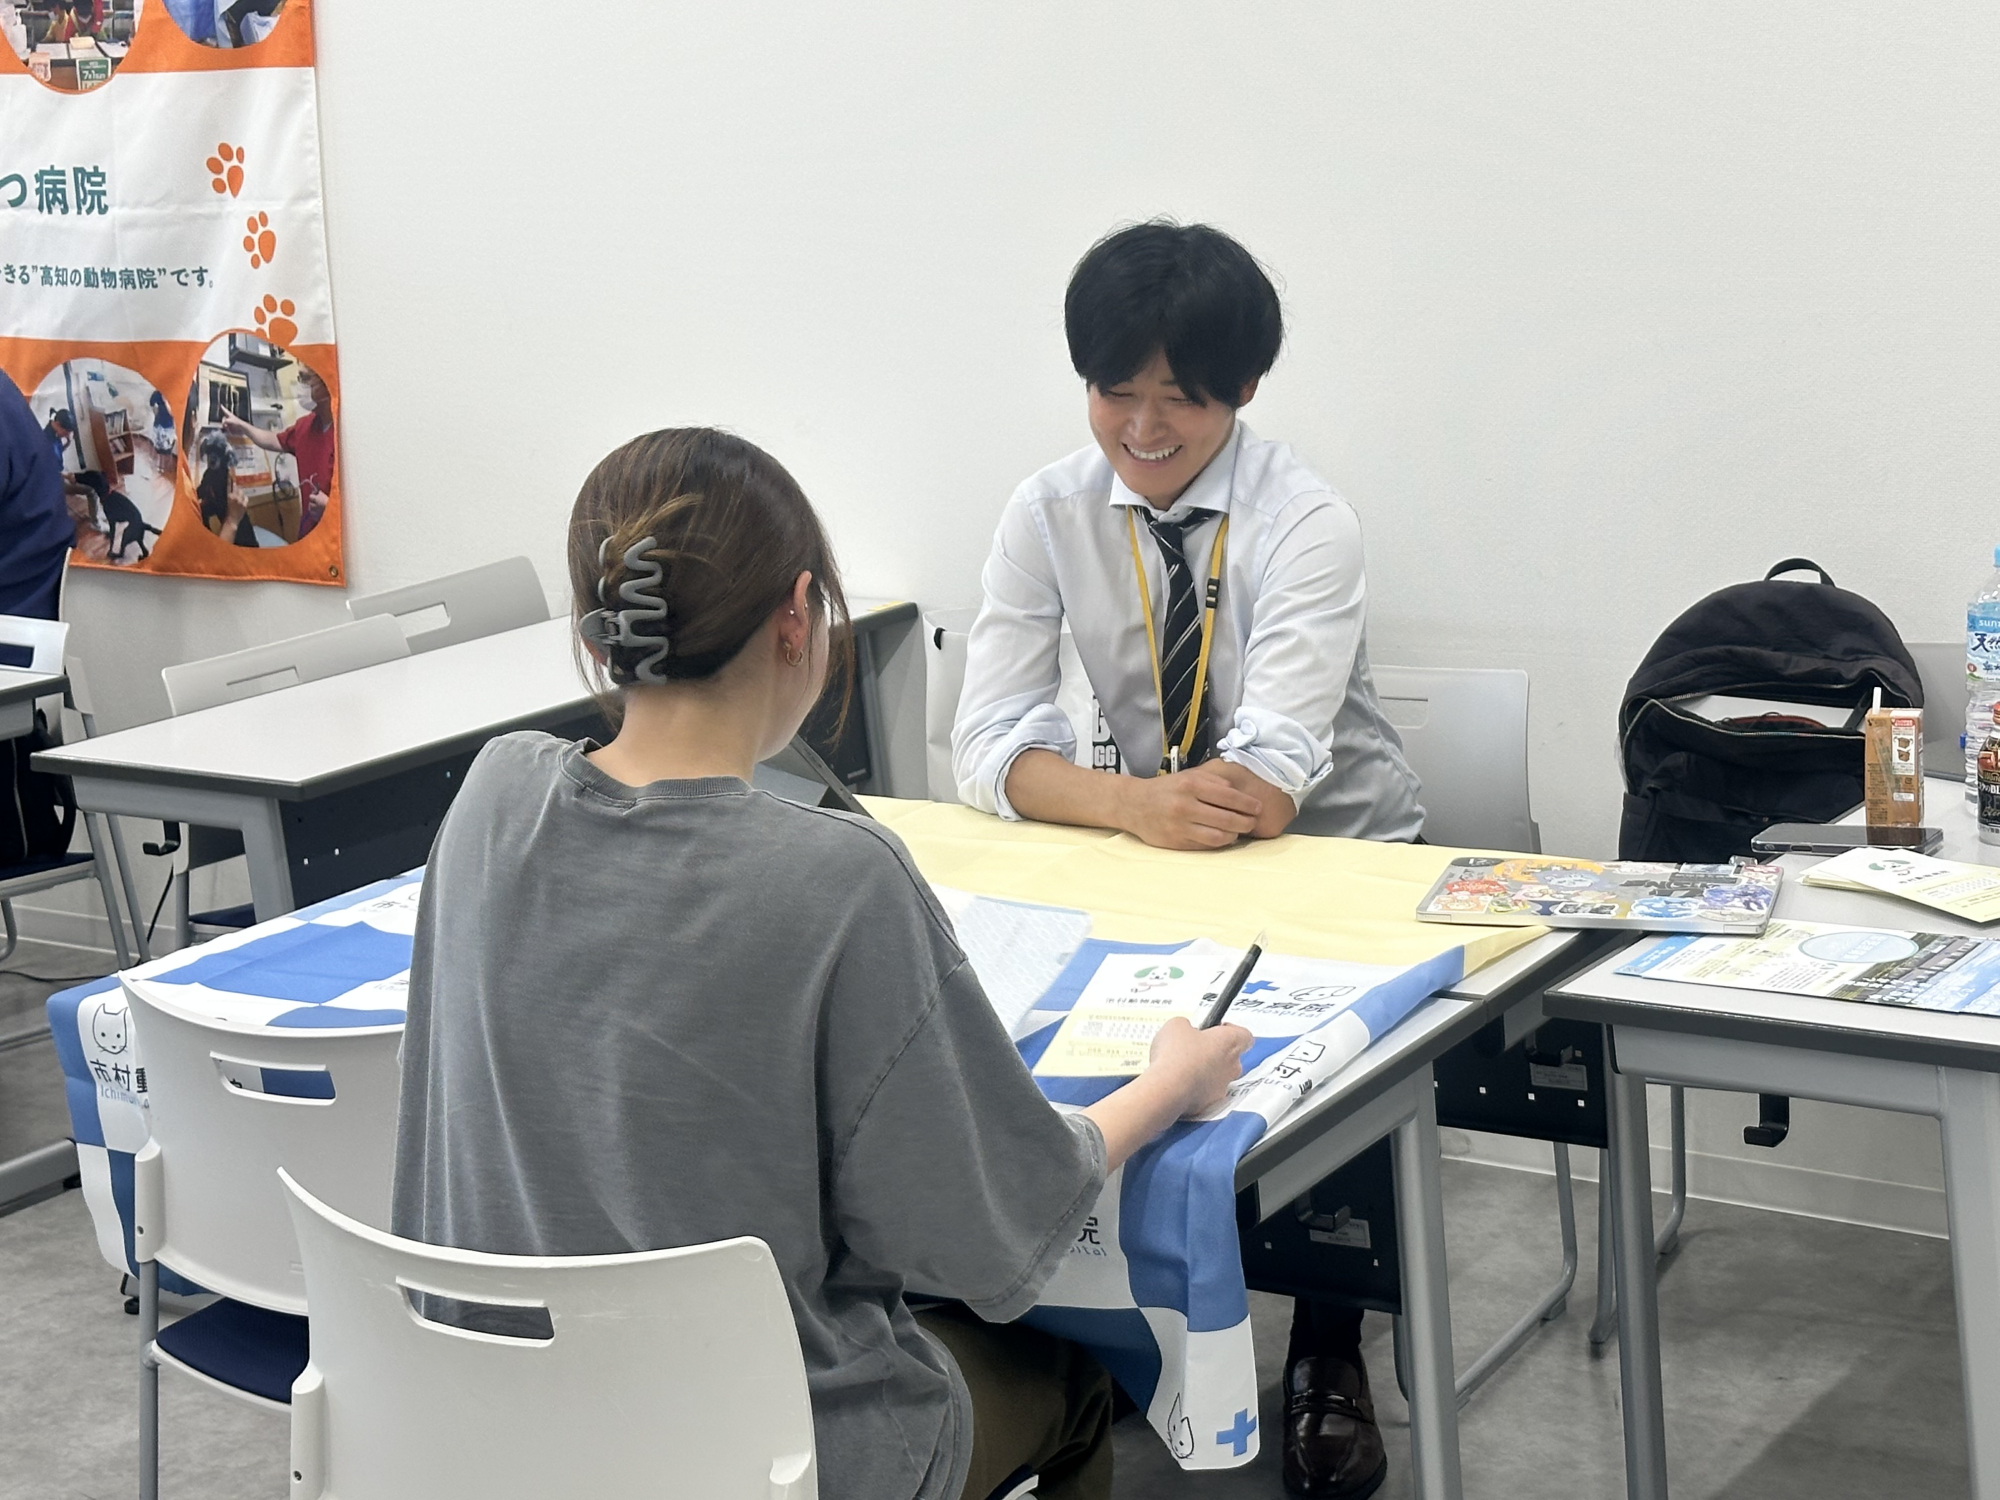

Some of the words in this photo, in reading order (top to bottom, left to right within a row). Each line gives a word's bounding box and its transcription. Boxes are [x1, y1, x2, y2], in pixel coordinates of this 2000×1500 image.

[0, 164, 109, 215] つ病院
[0, 263, 214, 290] きる”高知の動物病院”です。
